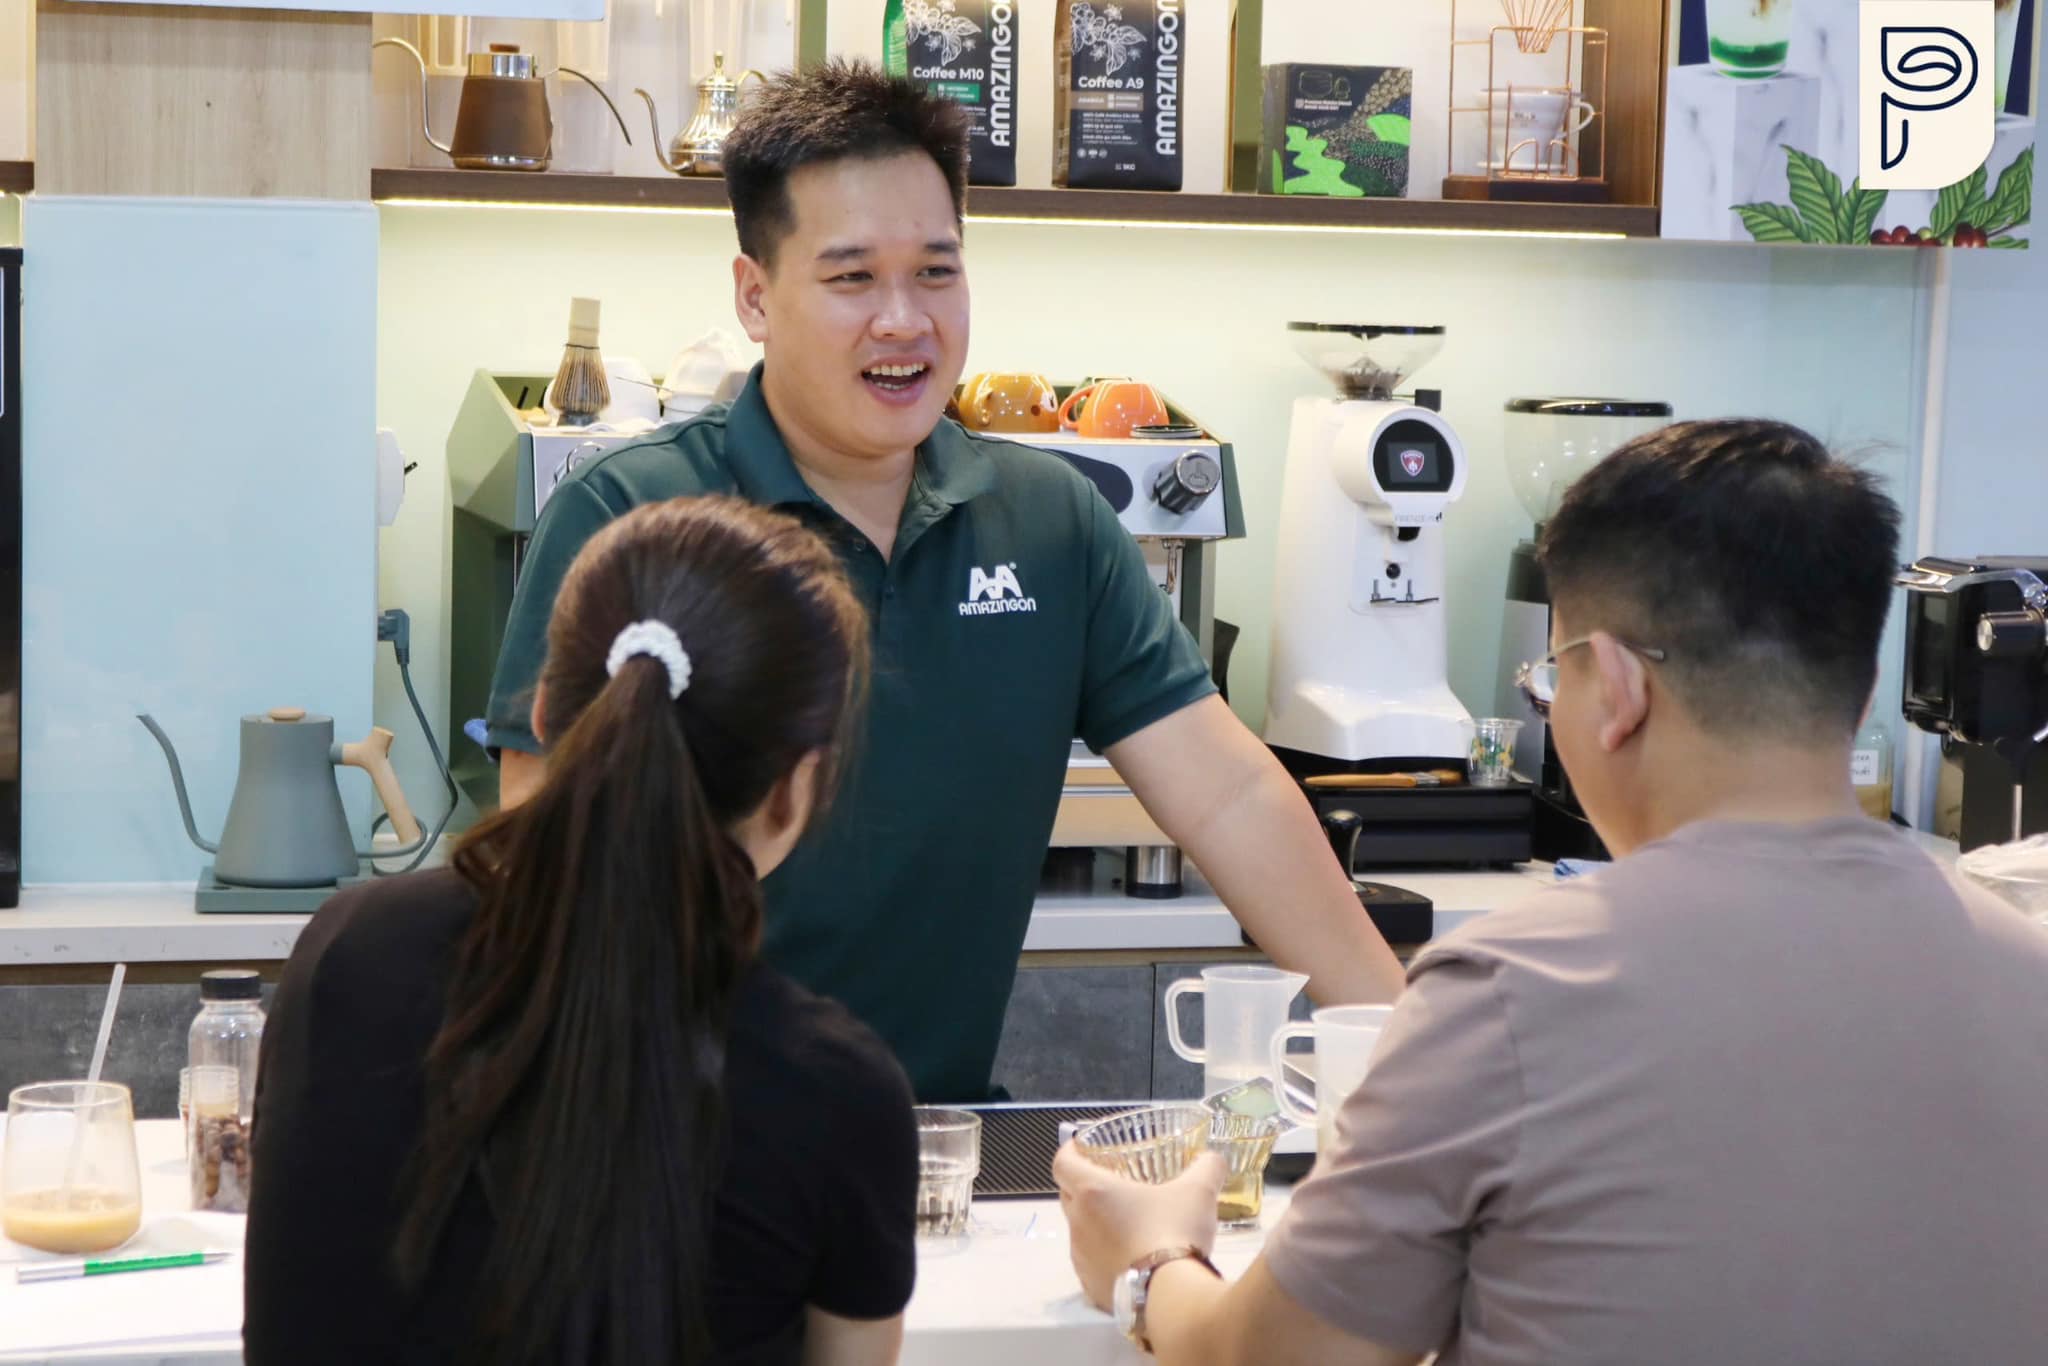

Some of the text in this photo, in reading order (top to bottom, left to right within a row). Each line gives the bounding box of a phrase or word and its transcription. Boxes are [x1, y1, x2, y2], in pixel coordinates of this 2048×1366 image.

[912, 66, 985, 81] Coffee M10
[990, 0, 1012, 146] AMAZINGO
[1078, 75, 1145, 90] Coffee A9
[958, 598, 1037, 616] AMAZINGON
